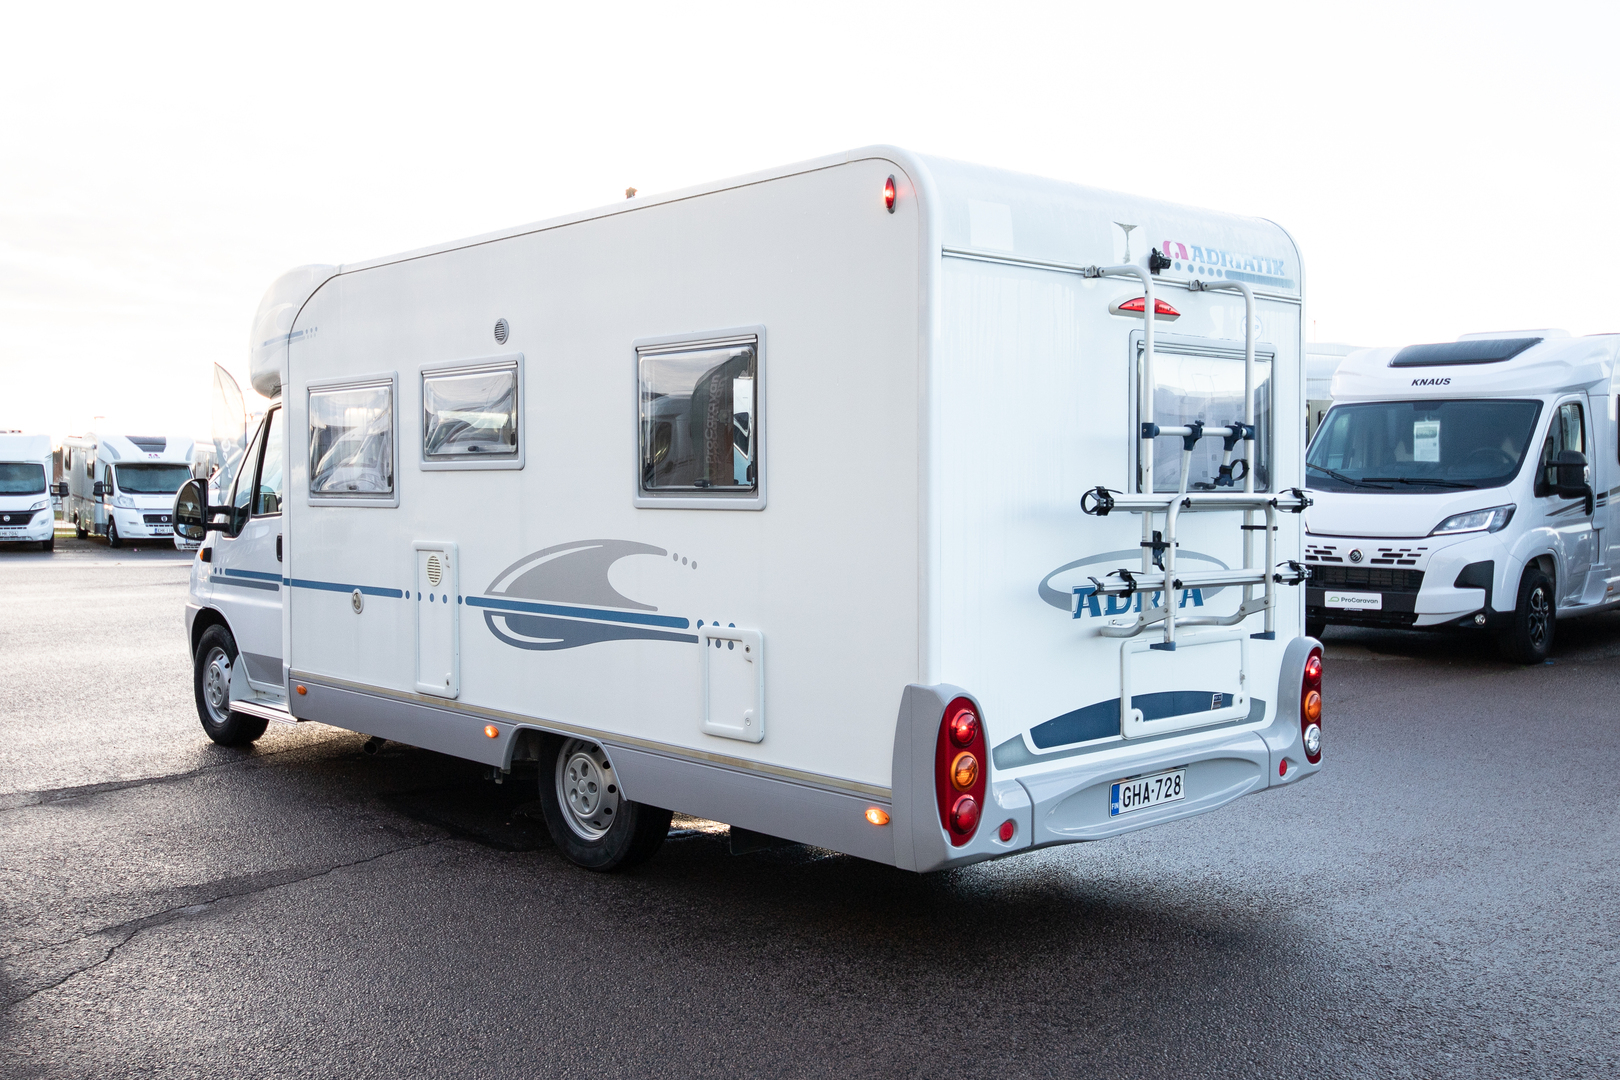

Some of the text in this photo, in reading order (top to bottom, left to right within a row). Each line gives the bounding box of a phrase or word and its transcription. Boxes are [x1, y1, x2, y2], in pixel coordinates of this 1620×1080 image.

[1190, 245, 1285, 276] ADRIATIK
[1411, 378, 1452, 386] KNAUS
[704, 374, 720, 464] ProCaravan
[1072, 585, 1204, 619] ADRA
[1111, 802, 1119, 810] FIN
[1122, 774, 1181, 808] GHA-728
